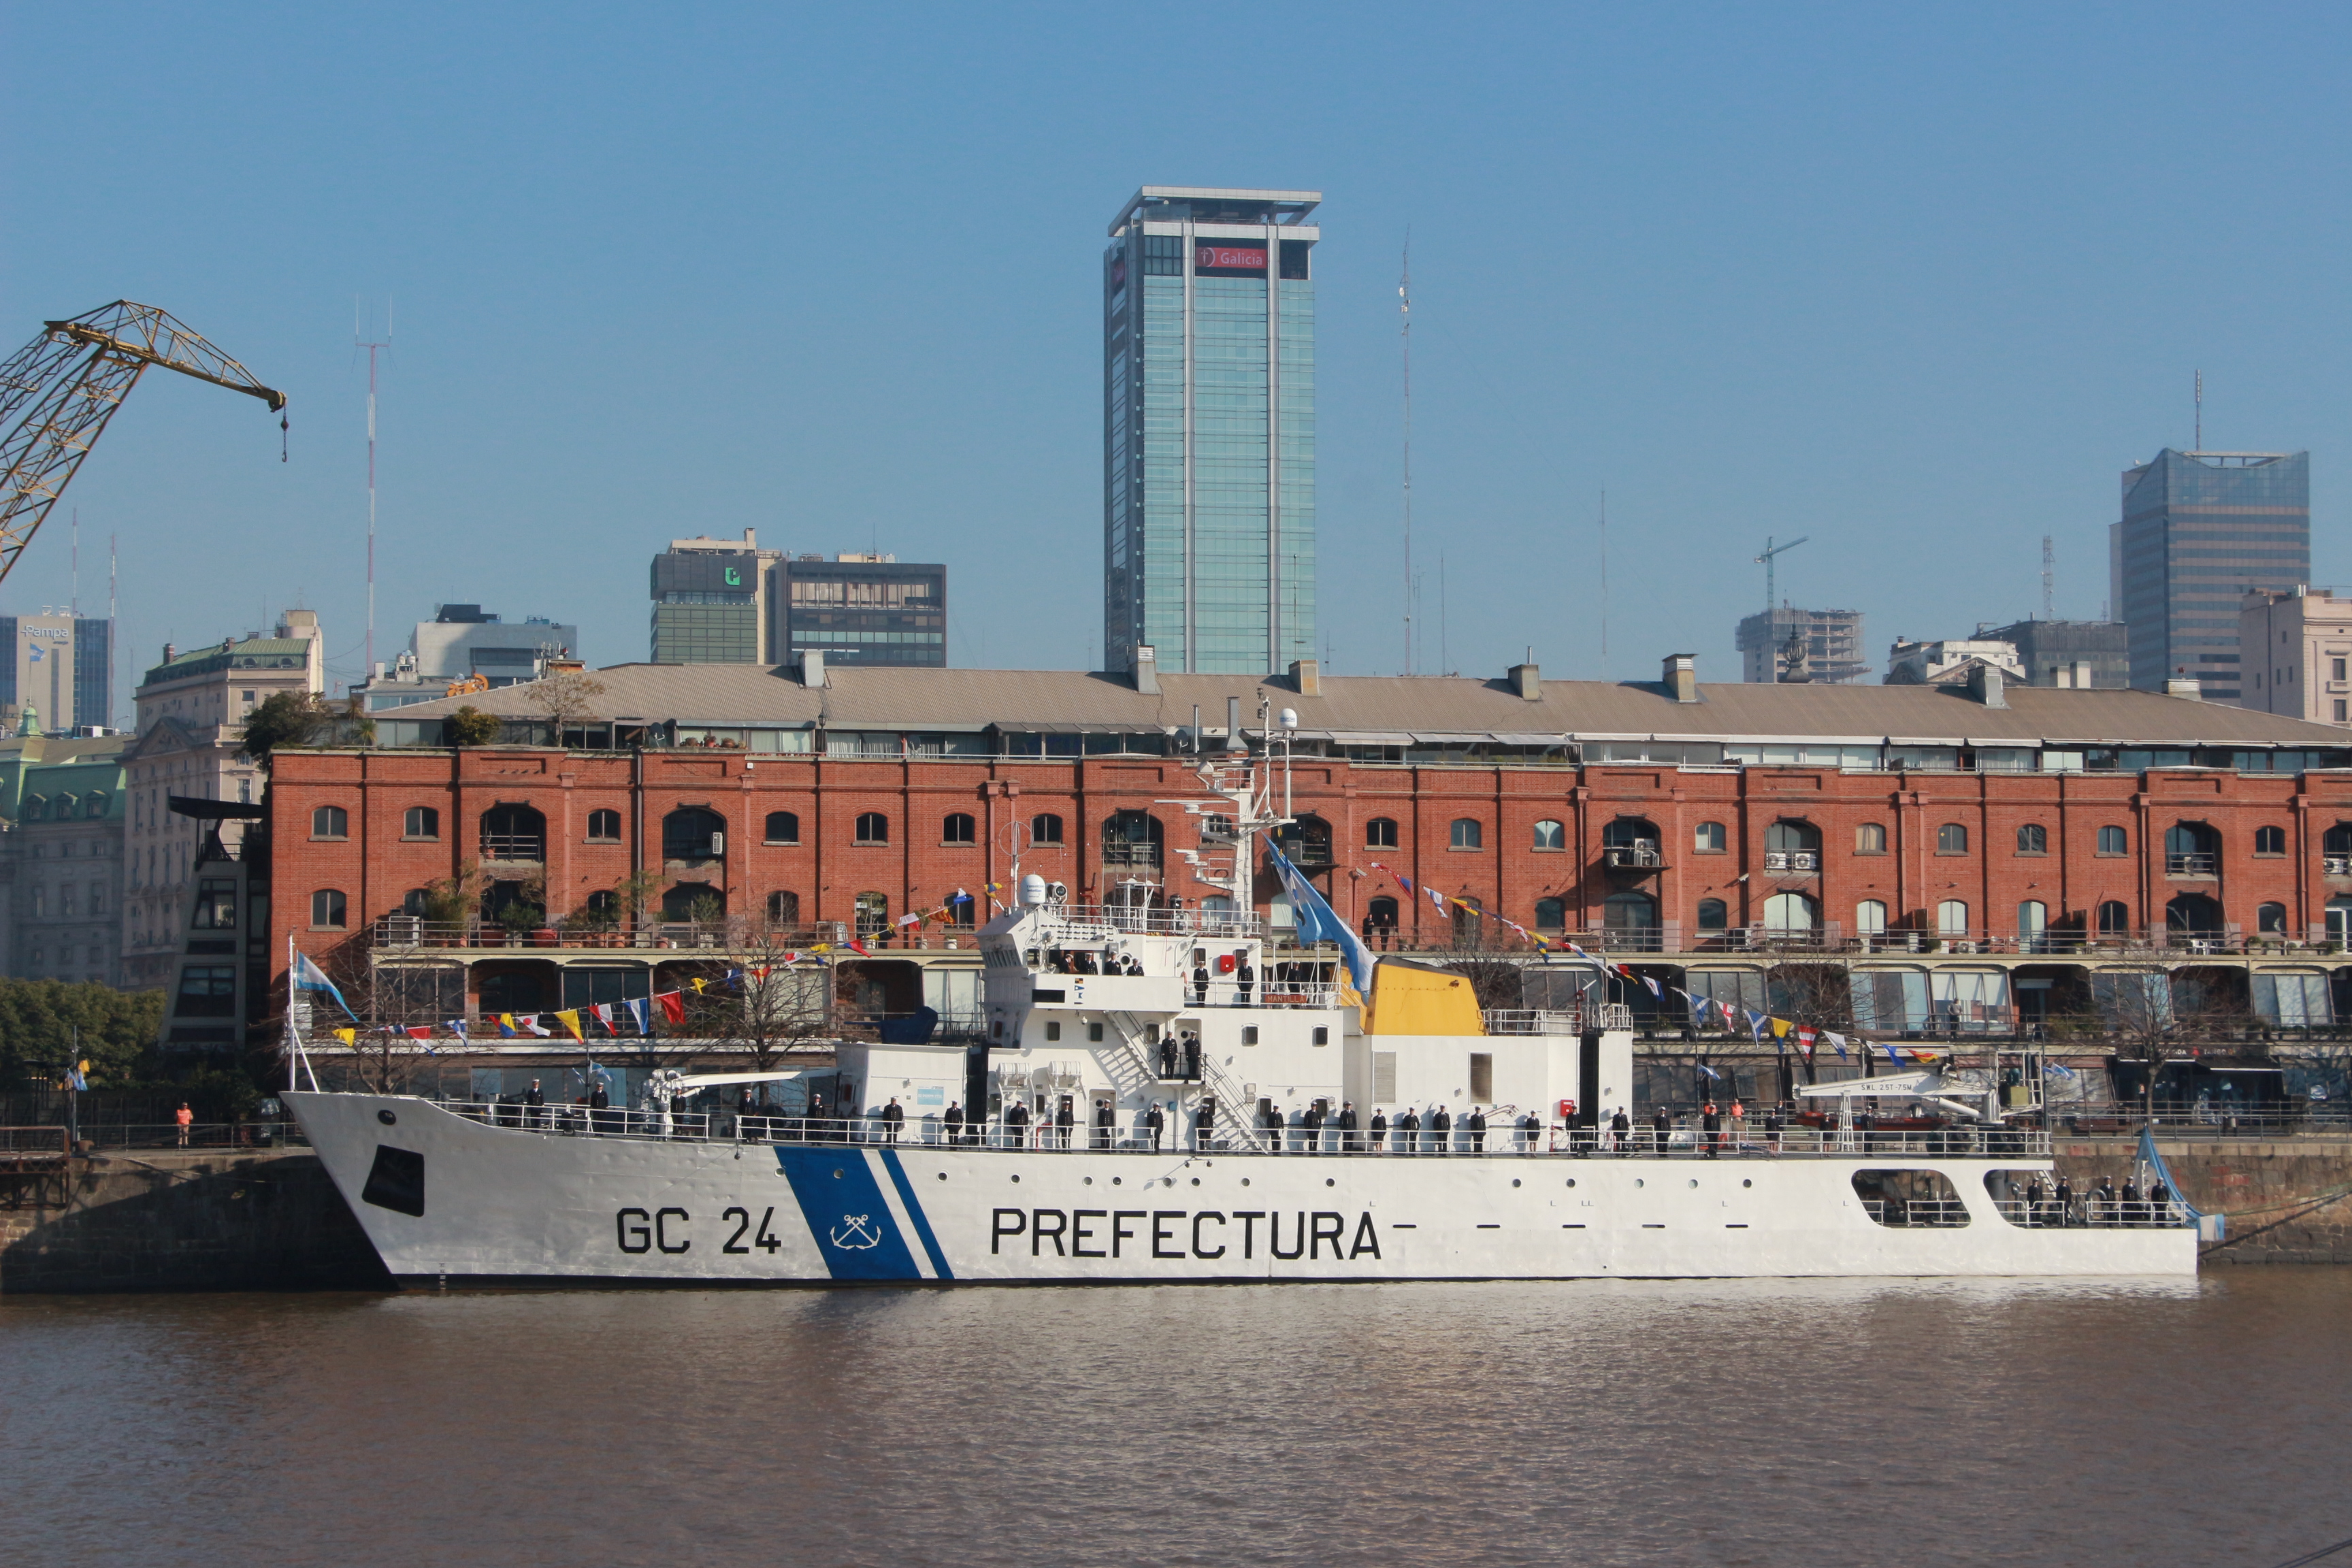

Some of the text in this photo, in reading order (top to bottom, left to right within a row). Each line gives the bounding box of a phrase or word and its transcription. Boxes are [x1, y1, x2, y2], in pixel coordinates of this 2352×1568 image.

[1220, 252, 1262, 265] Galicia
[24, 625, 69, 640] Pampa
[617, 1207, 782, 1254] GC 24
[992, 1208, 1382, 1260] PREFECTURA
